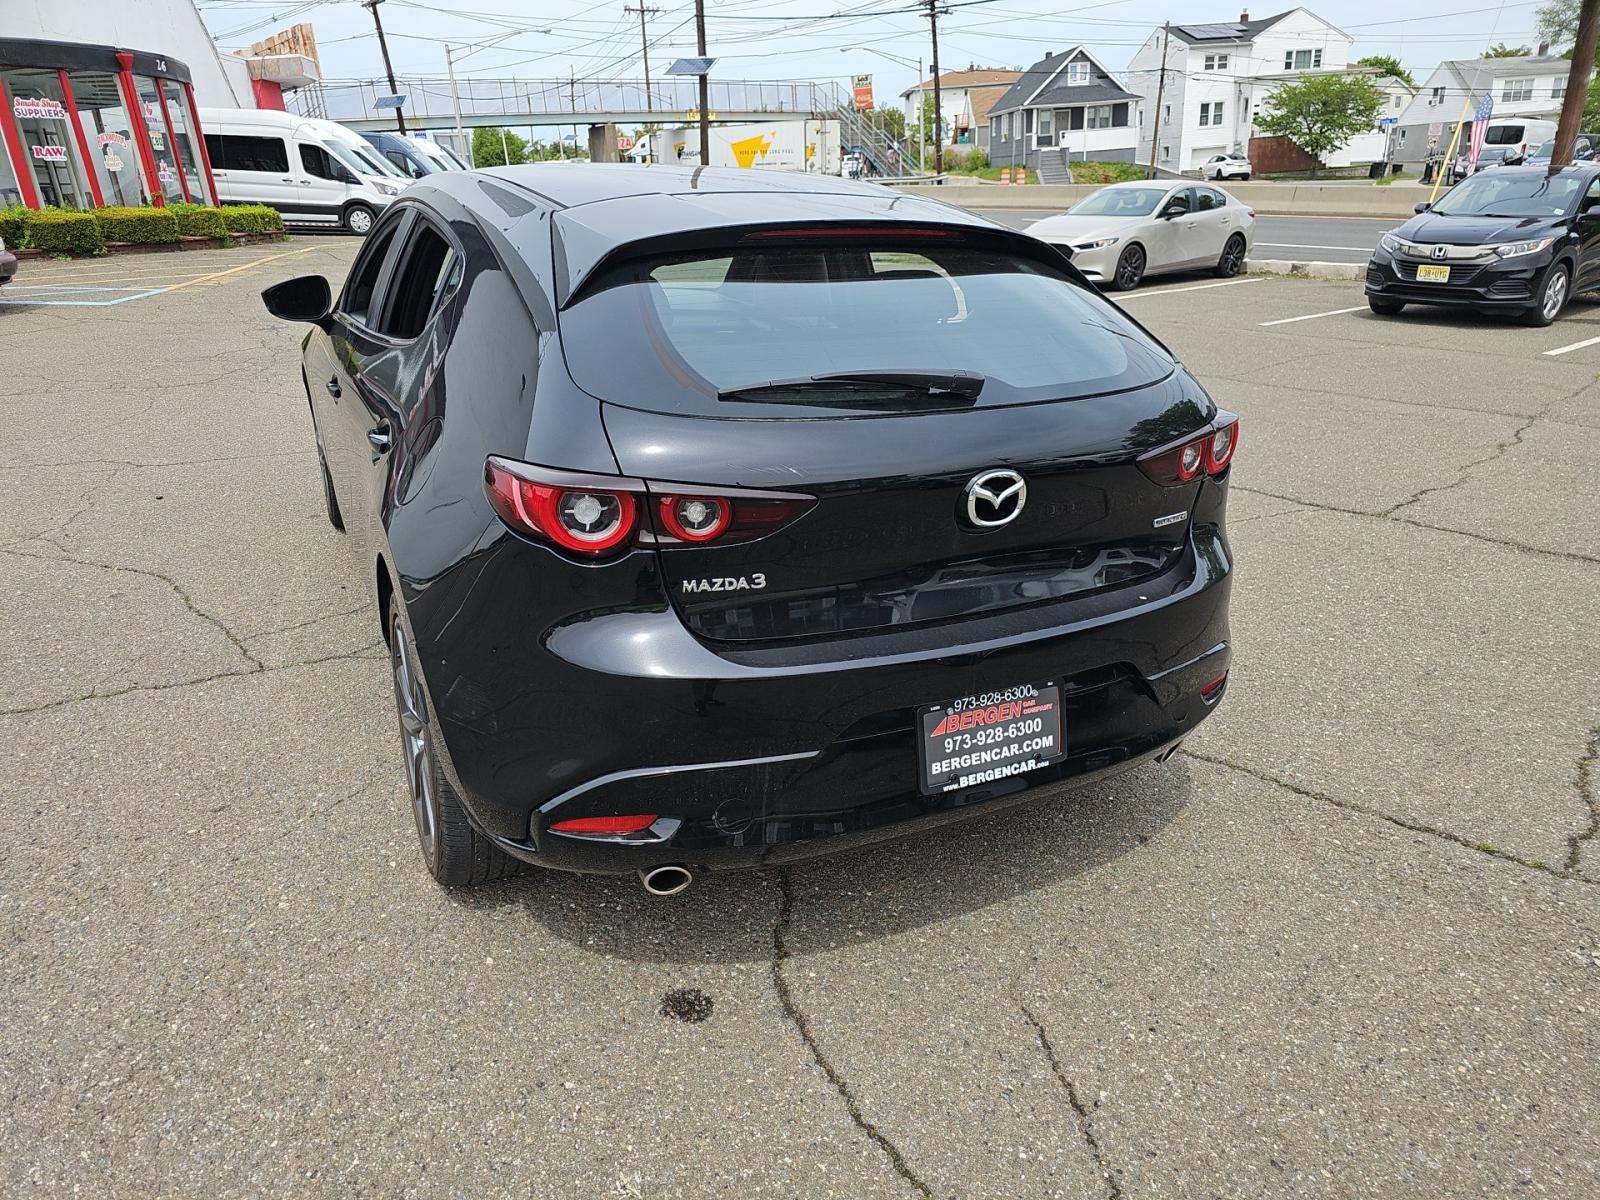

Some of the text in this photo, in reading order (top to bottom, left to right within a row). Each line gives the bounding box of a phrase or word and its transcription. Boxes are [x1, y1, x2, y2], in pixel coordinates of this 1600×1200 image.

[14, 98, 60, 109] Smoke Shop
[15, 108, 65, 118] SUPPLIERS
[34, 147, 64, 157] RAW
[953, 685, 1033, 712] 973-928-6300
[1023, 699, 1036, 707] CAR
[1023, 703, 1053, 714] COMPANY
[945, 701, 1024, 733] BERGEN
[944, 718, 1042, 753] 973-928-6300
[931, 735, 1054, 775] BERGENCAR.COM
